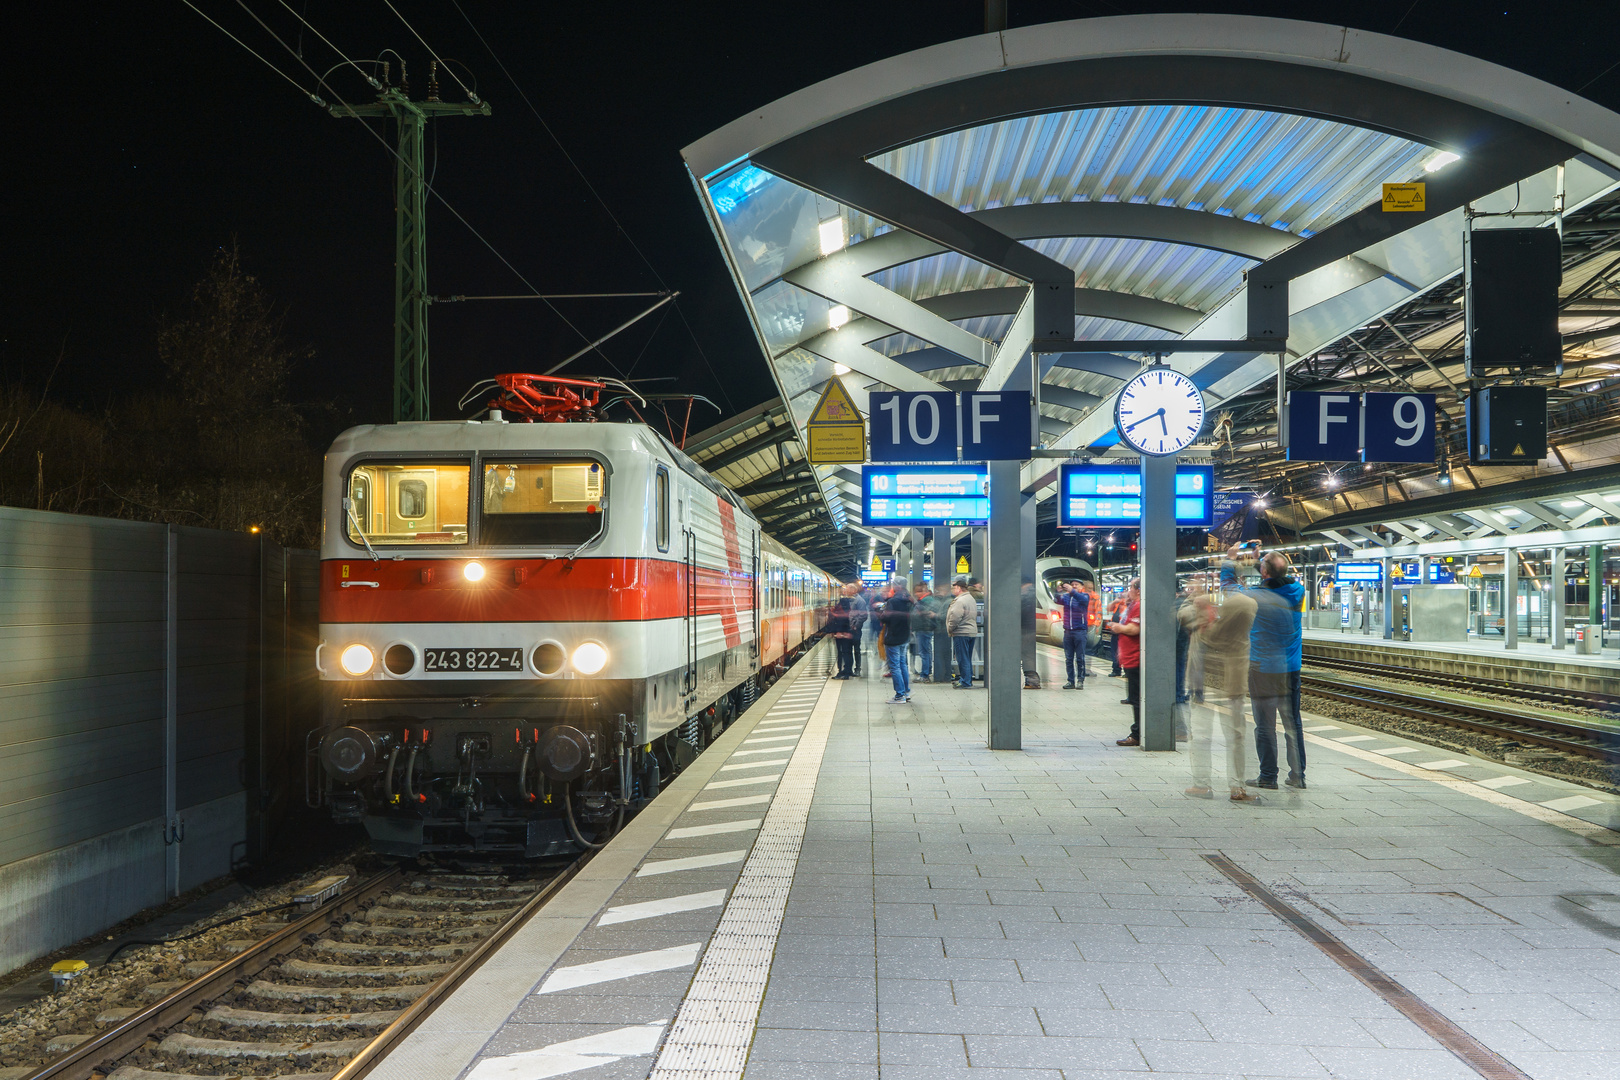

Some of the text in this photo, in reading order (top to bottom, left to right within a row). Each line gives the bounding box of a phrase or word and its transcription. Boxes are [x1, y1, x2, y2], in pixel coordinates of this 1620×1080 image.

[880, 394, 1001, 445] 10 F
[1319, 395, 1426, 447] F 9
[871, 475, 889, 491] 10
[1192, 474, 1203, 490] 9
[883, 559, 891, 570] E
[1406, 563, 1415, 575] F
[426, 650, 521, 669] 243 822-4
